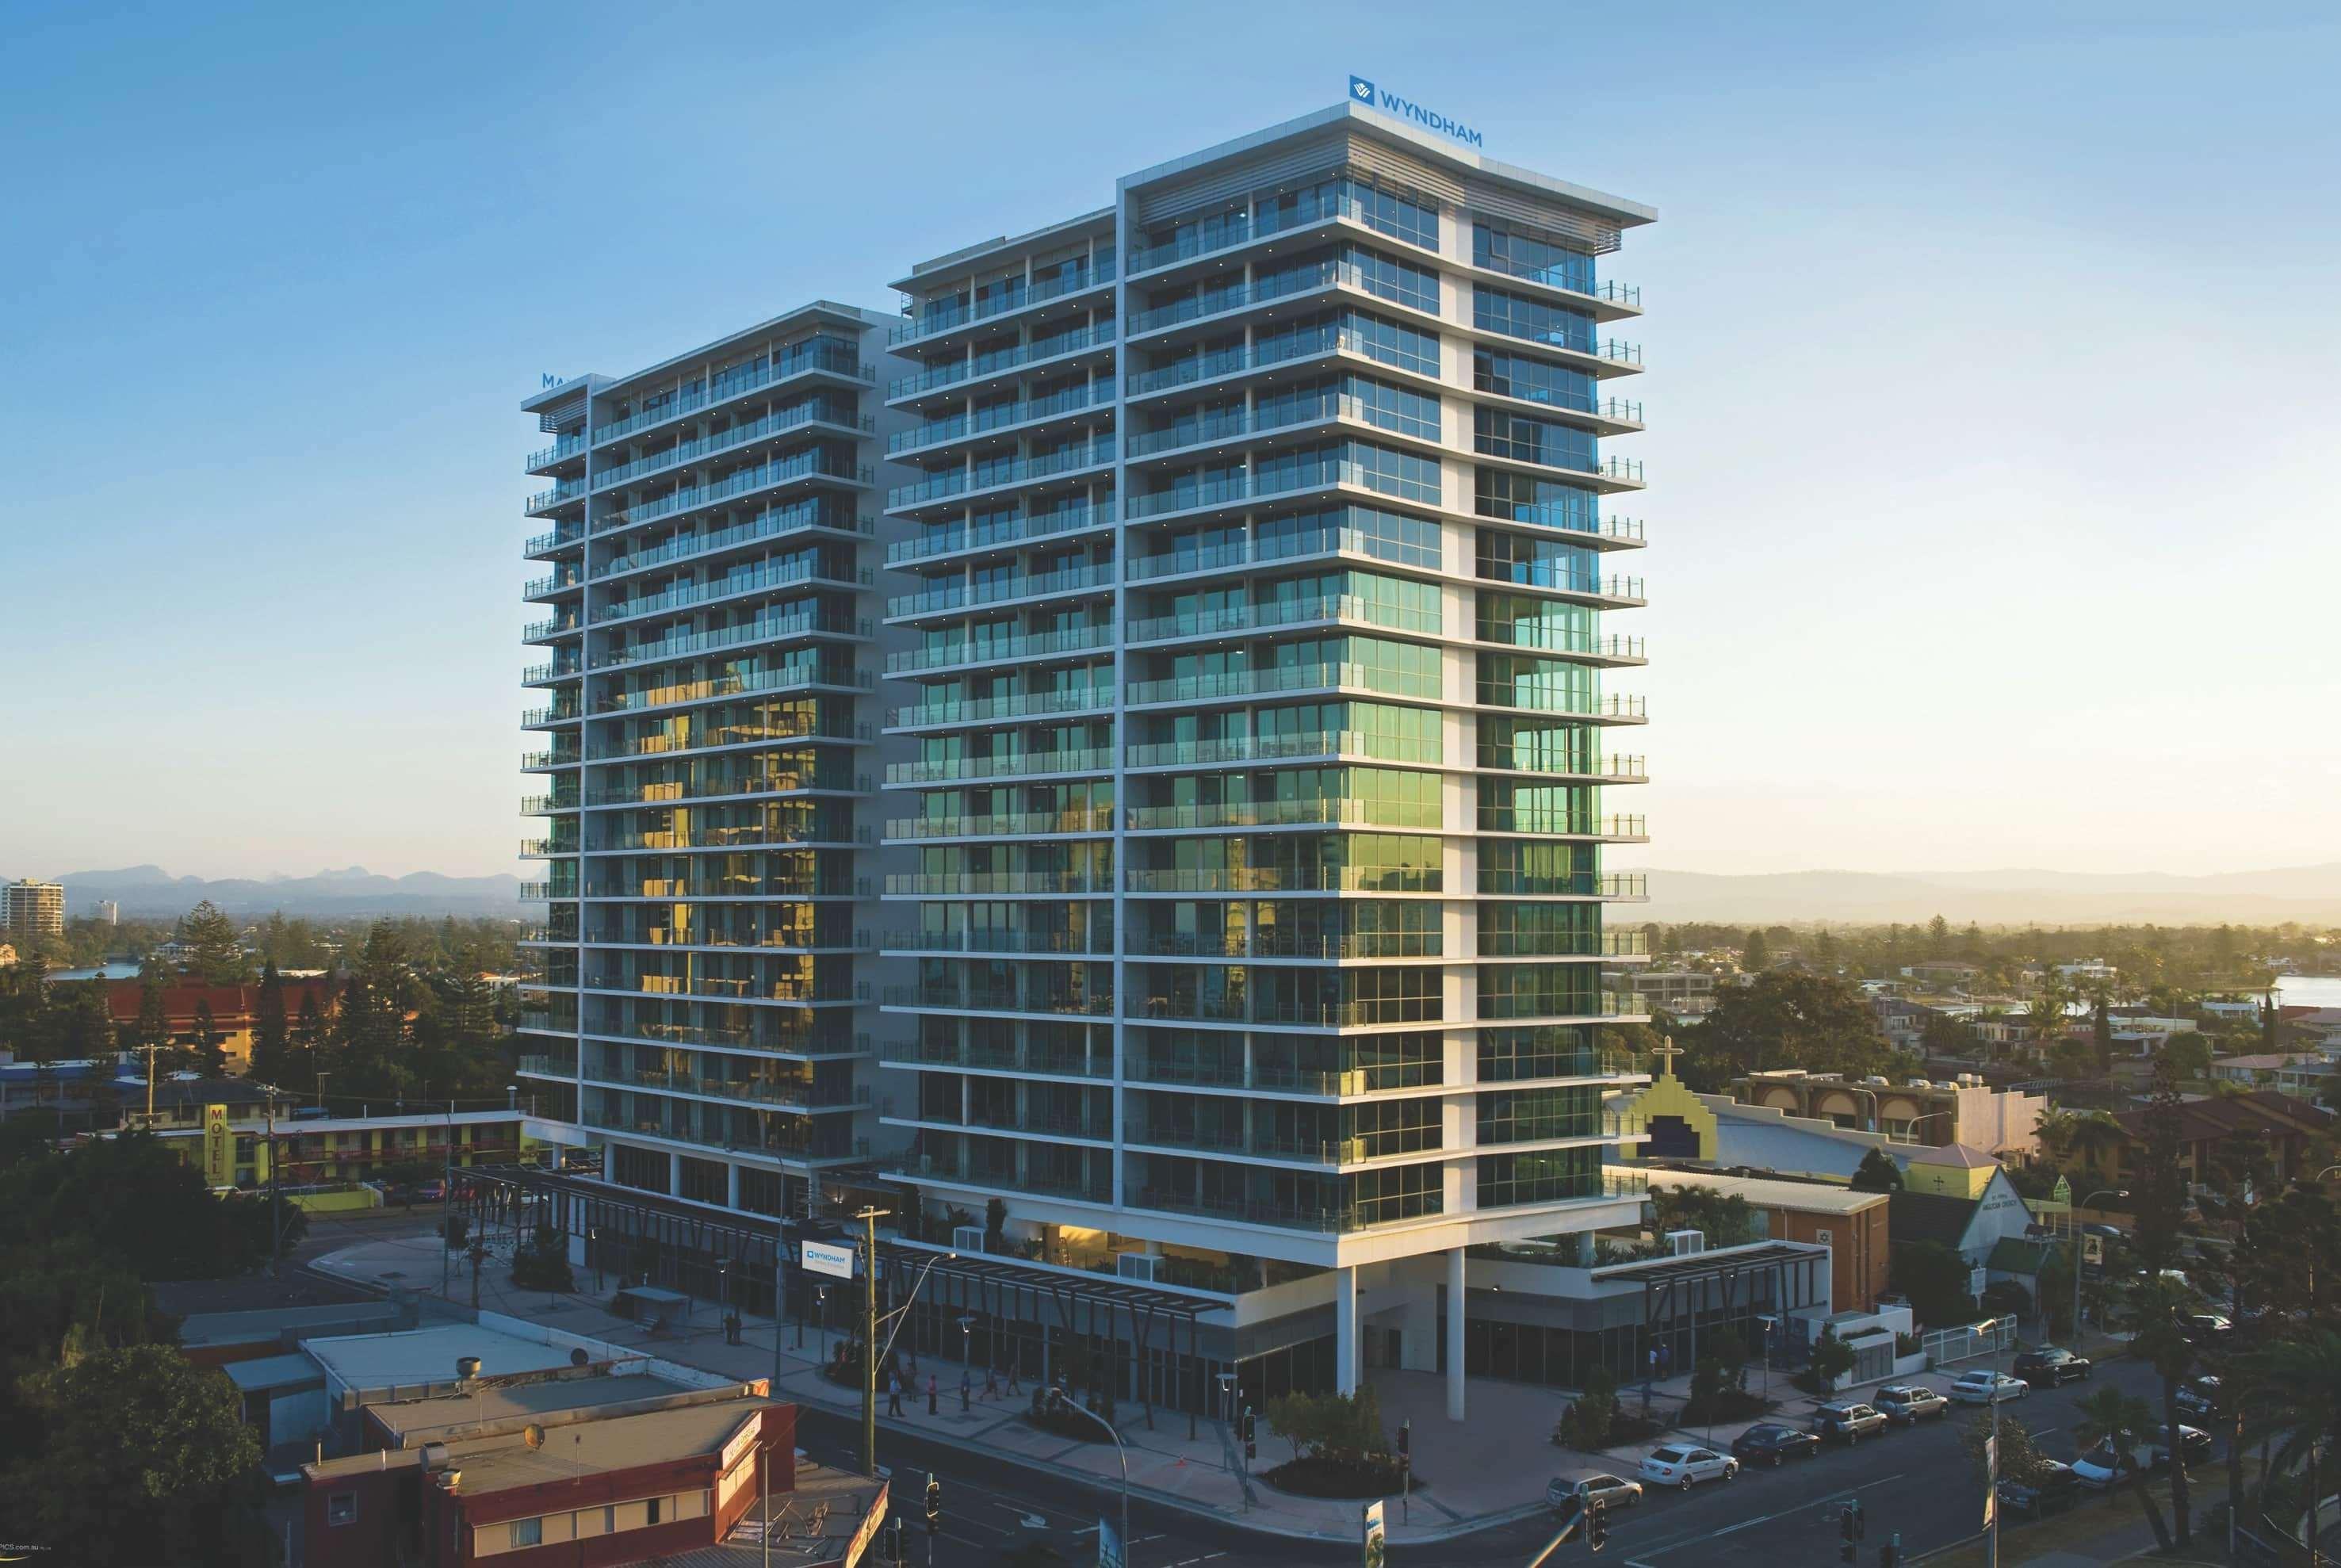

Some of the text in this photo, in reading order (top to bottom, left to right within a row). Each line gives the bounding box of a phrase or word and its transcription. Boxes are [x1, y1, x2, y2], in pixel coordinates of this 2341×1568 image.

[1380, 90, 1482, 148] WYNDHAM
[542, 372, 570, 388] MA
[211, 1109, 223, 1174] MOTEL
[814, 1251, 845, 1264] WYNDHAM
